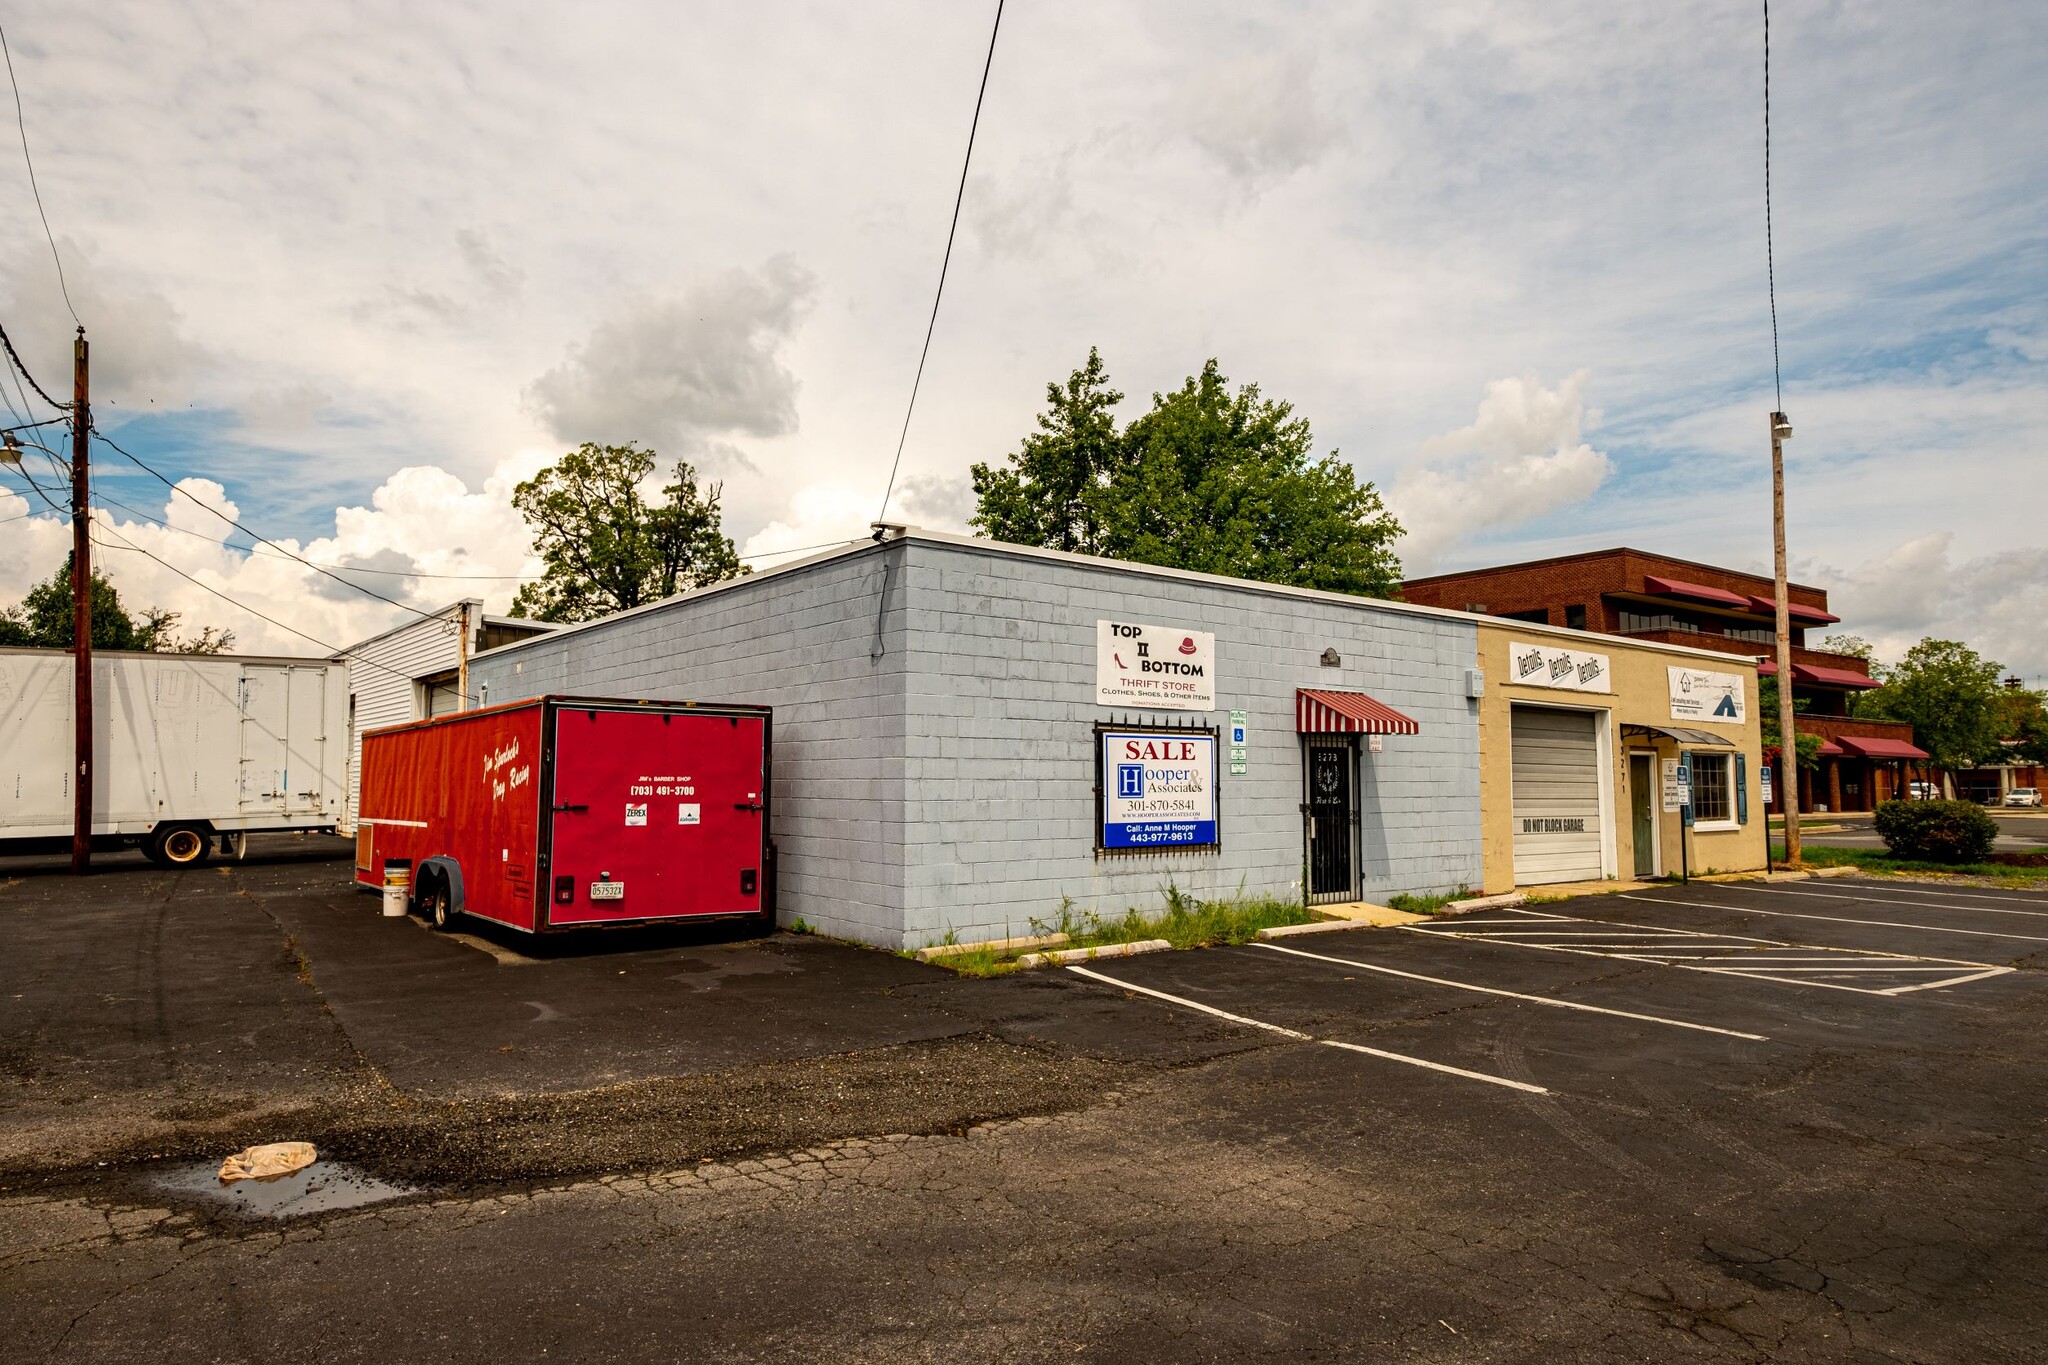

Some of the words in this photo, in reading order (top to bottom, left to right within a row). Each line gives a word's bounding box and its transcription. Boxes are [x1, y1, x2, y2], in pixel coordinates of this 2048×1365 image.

[1111, 624, 1142, 638] TOP
[1137, 642, 1149, 657] II
[1142, 660, 1204, 677] BOTTOM
[1120, 678, 1160, 689] THRIFT
[1162, 681, 1196, 692] STORE
[1126, 741, 1196, 760] SALE
[510, 764, 529, 791] Racing
[630, 785, 653, 796] (703)
[656, 786, 695, 796] 491-3700
[1147, 782, 1203, 793] Associates
[1127, 800, 1195, 811] 301-870-5841
[627, 809, 646, 817] ZEREX
[1126, 824, 1143, 833] Call:
[1144, 824, 1162, 832] Anne
[1172, 823, 1196, 833] Hooper
[1523, 819, 1531, 832] DO
[1532, 819, 1543, 832] NOT
[1545, 819, 1562, 832] BLOCK
[1563, 818, 1584, 832] GARAGE
[1130, 832, 1193, 842] 443-977-9613
